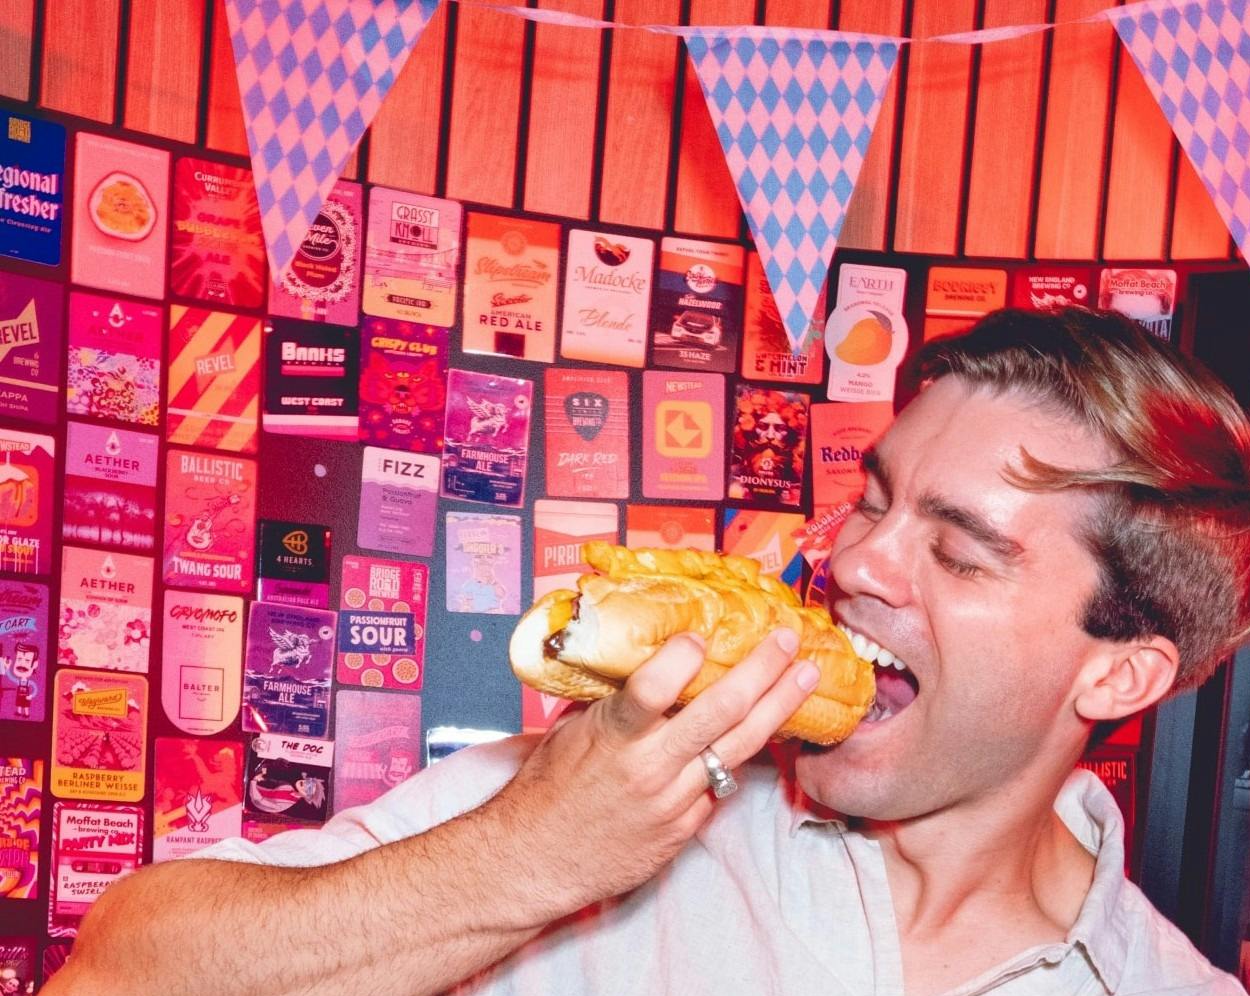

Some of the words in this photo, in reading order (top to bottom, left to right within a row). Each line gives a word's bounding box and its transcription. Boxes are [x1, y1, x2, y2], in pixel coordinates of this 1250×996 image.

[396, 206, 434, 223] GRASSY
[573, 265, 647, 294] Madocke
[1032, 282, 1060, 290] BREWING
[1110, 279, 1139, 289] Moffat
[1141, 280, 1168, 290] Beach
[479, 314, 508, 328] RED
[515, 318, 543, 331] ALE
[196, 354, 235, 375] REVEL
[769, 360, 808, 375] MINT
[281, 396, 309, 406] WEST
[572, 398, 603, 407] SIX
[84, 453, 140, 471] AETHER
[461, 448, 509, 463] FARMHOUSE
[181, 455, 243, 481] BALLISTIC
[382, 459, 426, 479] FIZZ
[474, 460, 493, 472] ALE
[739, 475, 792, 489] DIONYSUS
[12, 536, 40, 548] GLAZE
[283, 556, 313, 566] HEARTS
[172, 558, 211, 577] TWANG
[213, 563, 242, 580] SOUR
[370, 566, 401, 580] BRIDGE
[80, 577, 135, 594] AETHER
[4, 617, 29, 630] CART
[350, 615, 407, 627] PASSIONFRUIT
[350, 626, 407, 647] SOUR
[183, 682, 220, 693] BALTER
[263, 680, 312, 696] FARMHOUSE
[278, 691, 295, 704] ALE
[280, 740, 302, 751] THE
[303, 743, 324, 754] DOC
[73, 771, 124, 782] RASPBERRY
[57, 779, 102, 789] BERLINER
[105, 782, 138, 791] WEISSE
[67, 815, 101, 827] Moffat
[103, 818, 134, 828] Beach
[78, 826, 109, 836] brewing
[62, 835, 106, 850] PARTY
[109, 832, 135, 847] MIX
[166, 836, 196, 844] RAMPANT
